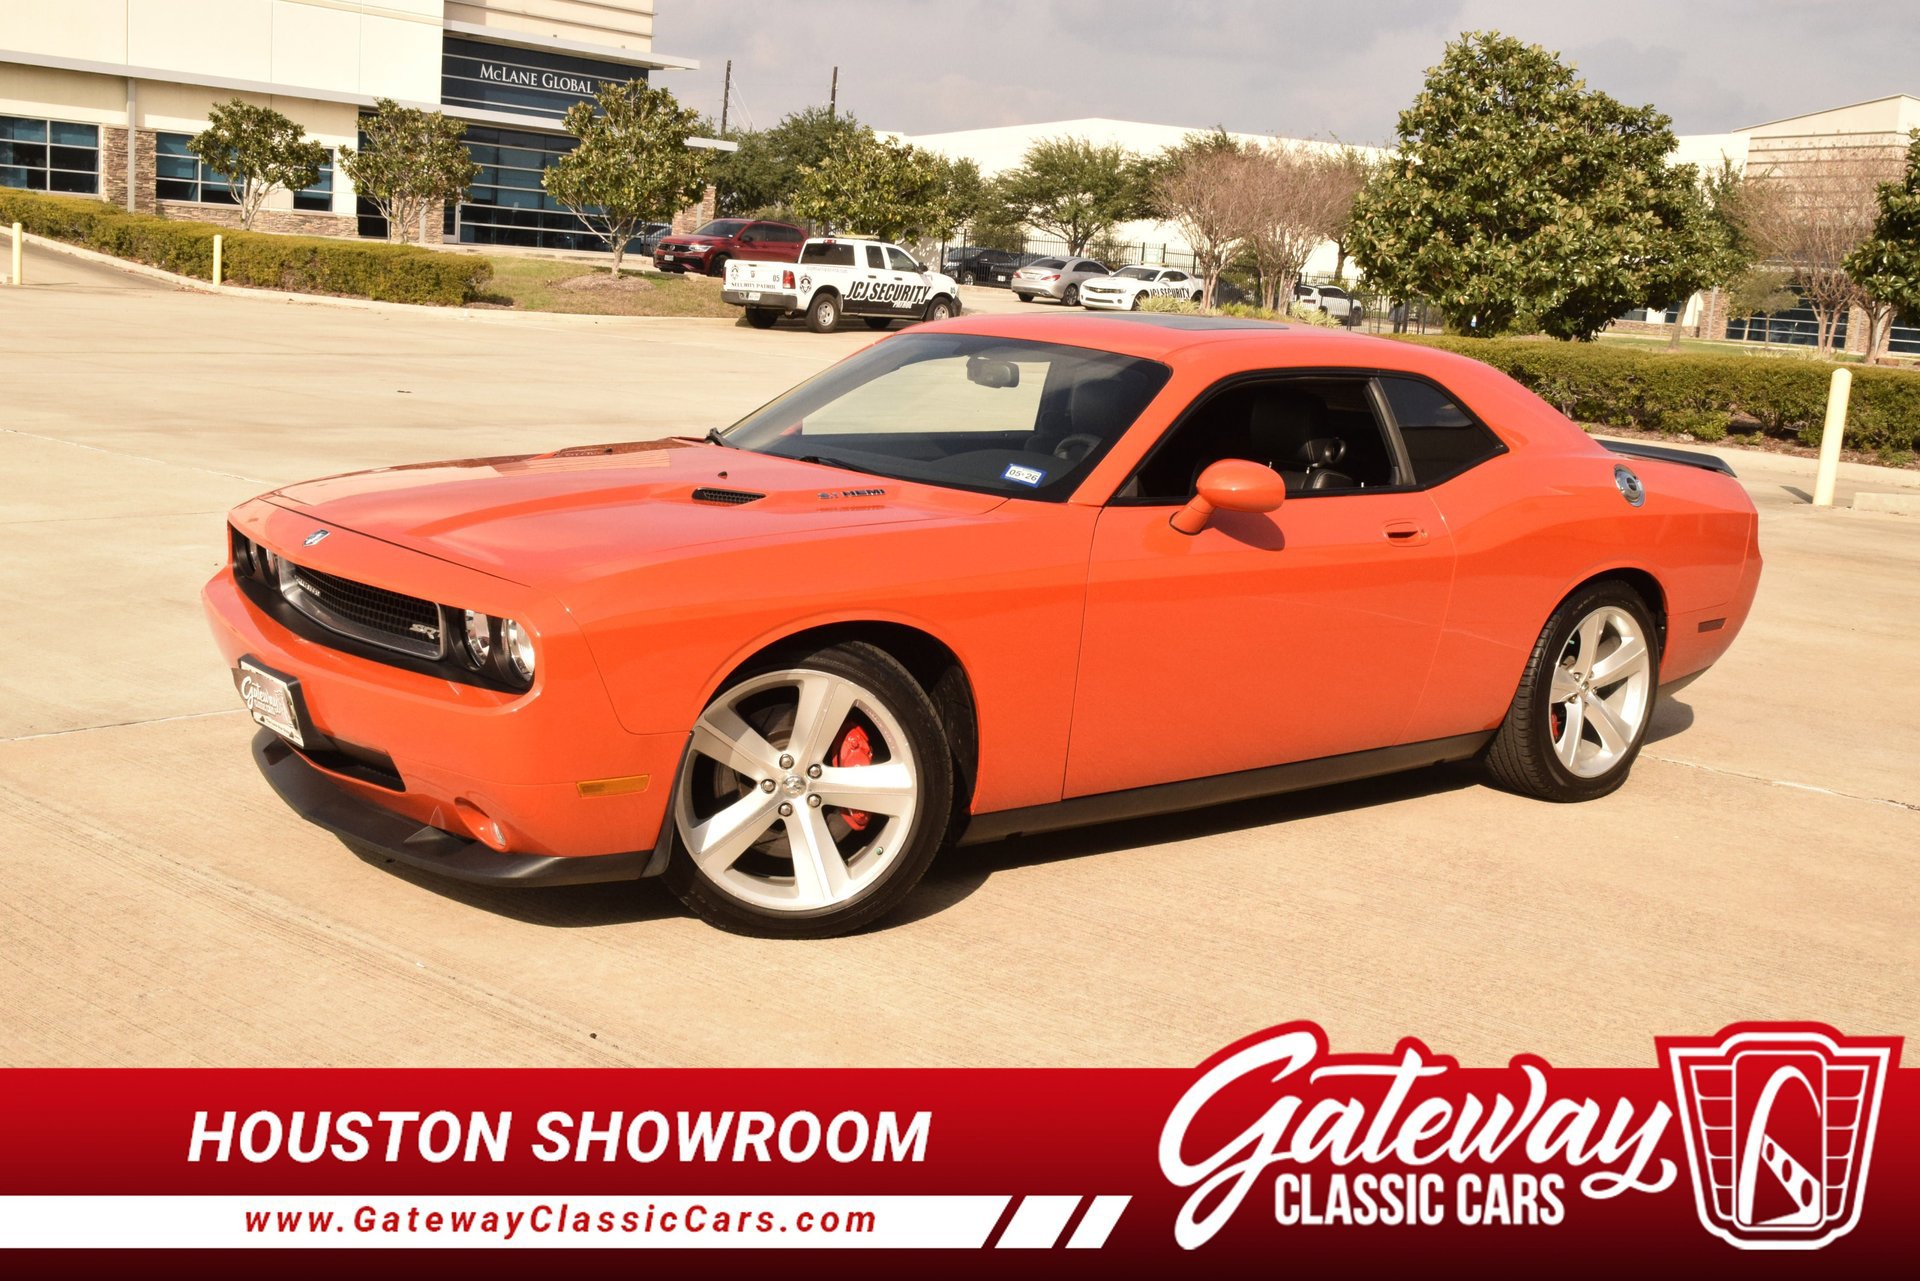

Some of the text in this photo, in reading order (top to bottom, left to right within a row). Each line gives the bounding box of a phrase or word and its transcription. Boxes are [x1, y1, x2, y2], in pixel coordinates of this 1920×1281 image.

[773, 274, 780, 282] 05
[847, 280, 931, 303] JCJ SECURITY
[841, 488, 885, 497] HEMI
